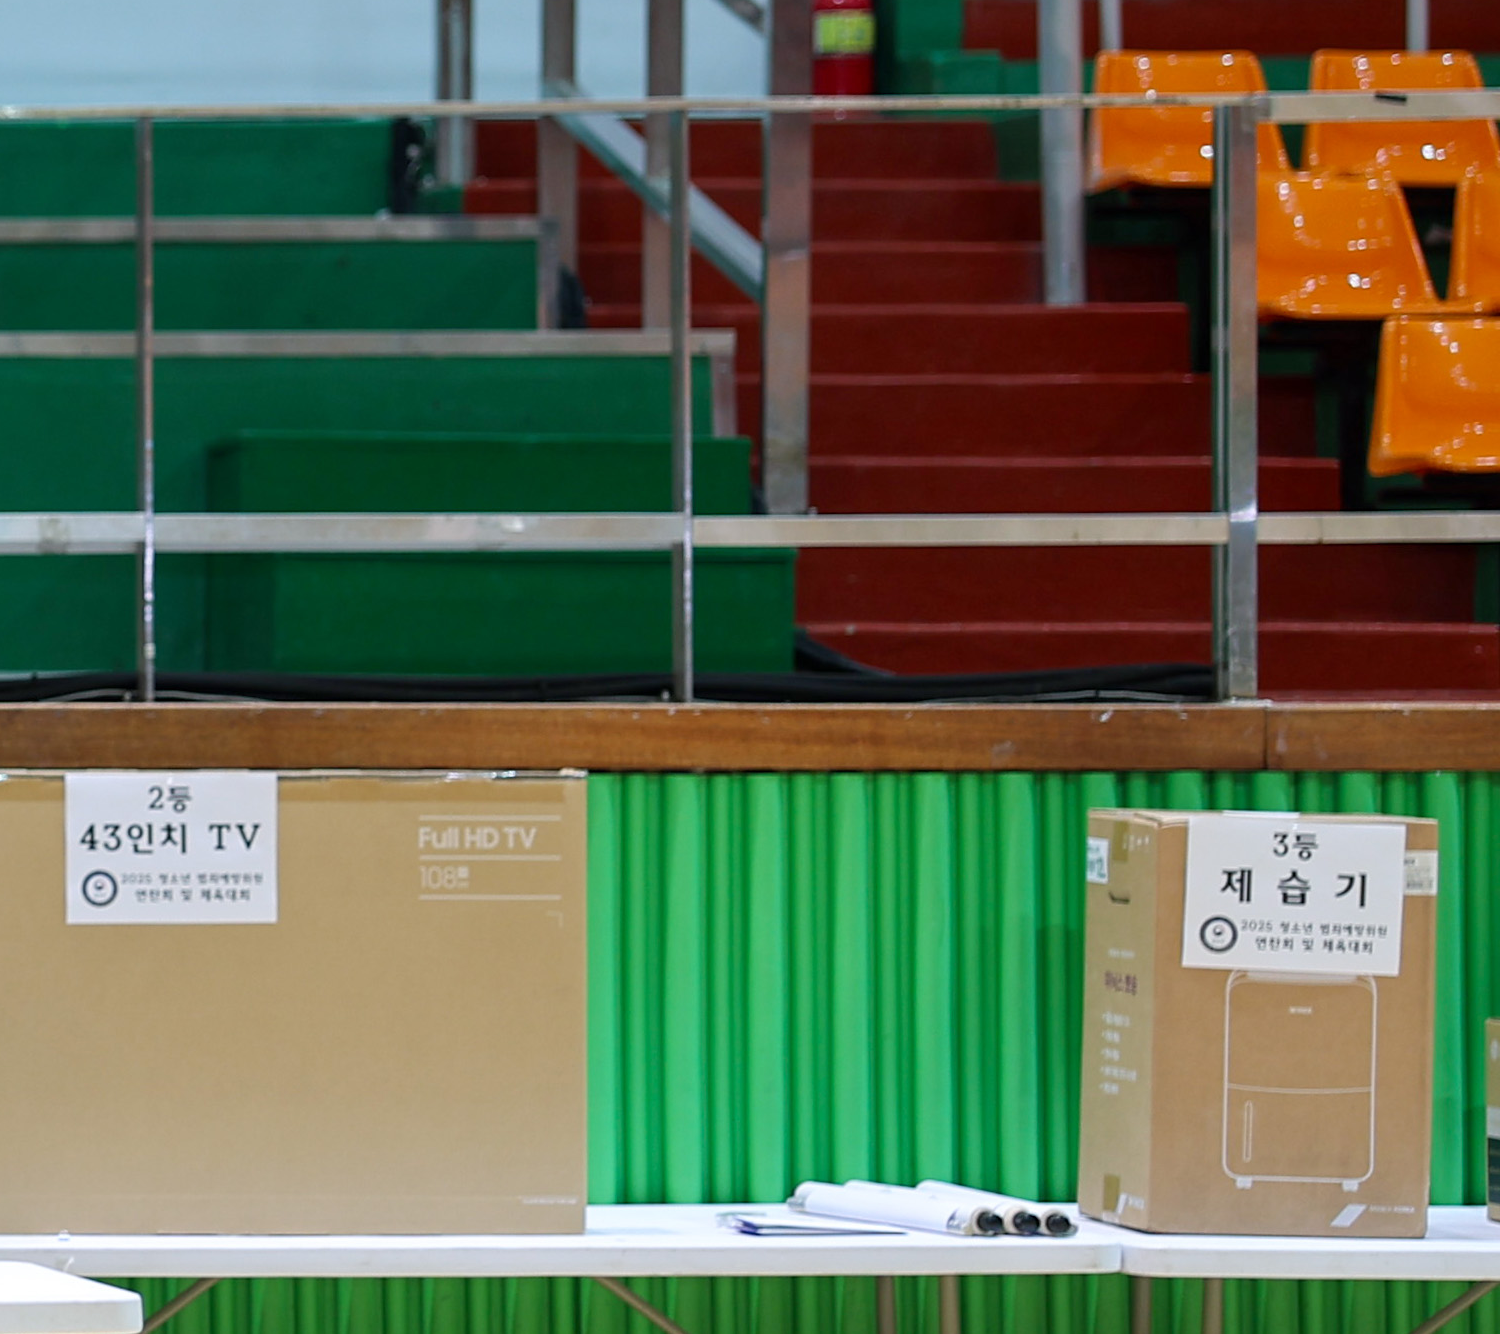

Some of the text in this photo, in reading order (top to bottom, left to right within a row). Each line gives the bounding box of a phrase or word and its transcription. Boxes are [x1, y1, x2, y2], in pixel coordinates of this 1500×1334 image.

[147, 784, 193, 814] 2등
[79, 823, 262, 855] 43인치 TV
[417, 826, 538, 850] Full HD TV
[1272, 831, 1320, 862] 3등
[419, 865, 457, 890] 108
[1240, 918, 1389, 939] 2025 청소년 범죄예방위원
[1322, 938, 1374, 955] 체육대회
